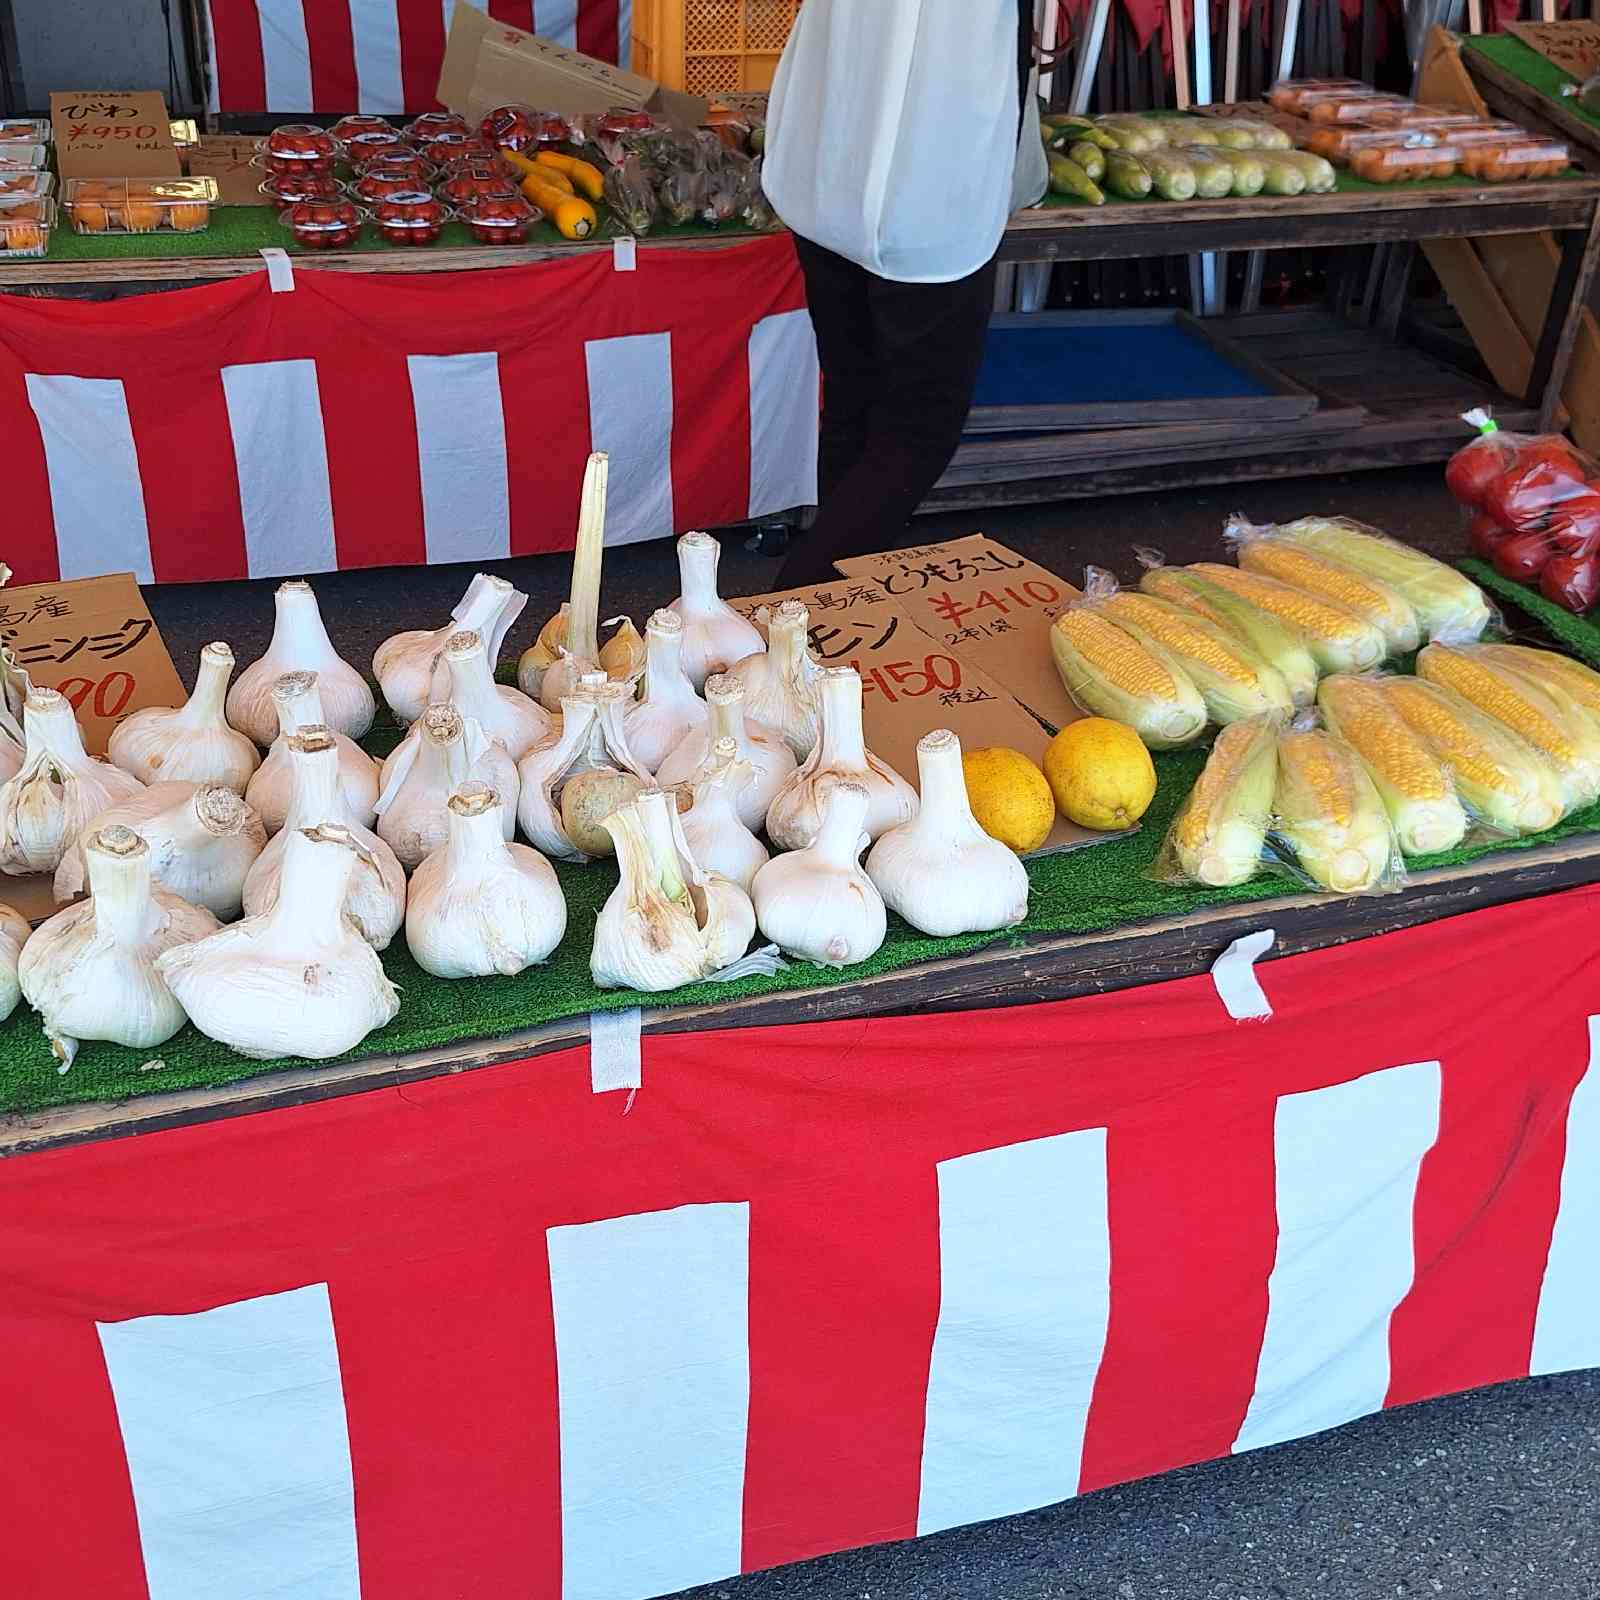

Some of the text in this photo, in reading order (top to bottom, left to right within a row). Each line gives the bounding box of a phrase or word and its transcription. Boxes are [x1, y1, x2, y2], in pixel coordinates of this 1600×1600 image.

[60, 102, 139, 119] びわ
[67, 122, 157, 141] ¥950
[871, 550, 1024, 595] とうもろこし
[736, 585, 887, 622] 淡島産
[928, 581, 1059, 629] ¥410
[807, 616, 898, 659] モン
[33, 671, 136, 718] 90
[939, 686, 998, 708] 税込
